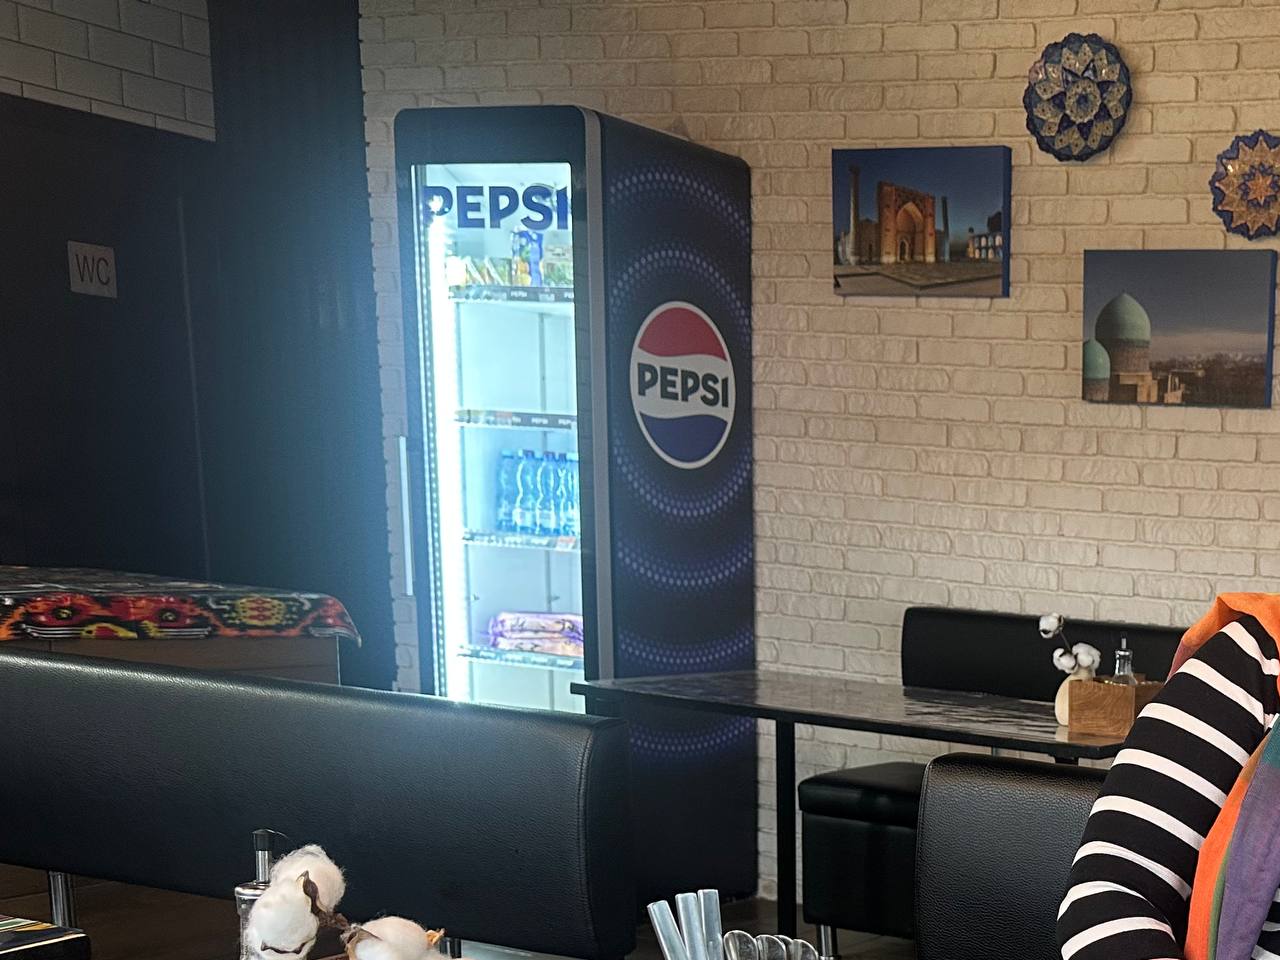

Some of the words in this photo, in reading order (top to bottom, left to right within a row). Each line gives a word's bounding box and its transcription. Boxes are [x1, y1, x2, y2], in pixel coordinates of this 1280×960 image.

[423, 185, 569, 230] PEPSI
[75, 254, 110, 286] WC
[637, 362, 729, 408] PEPSI
